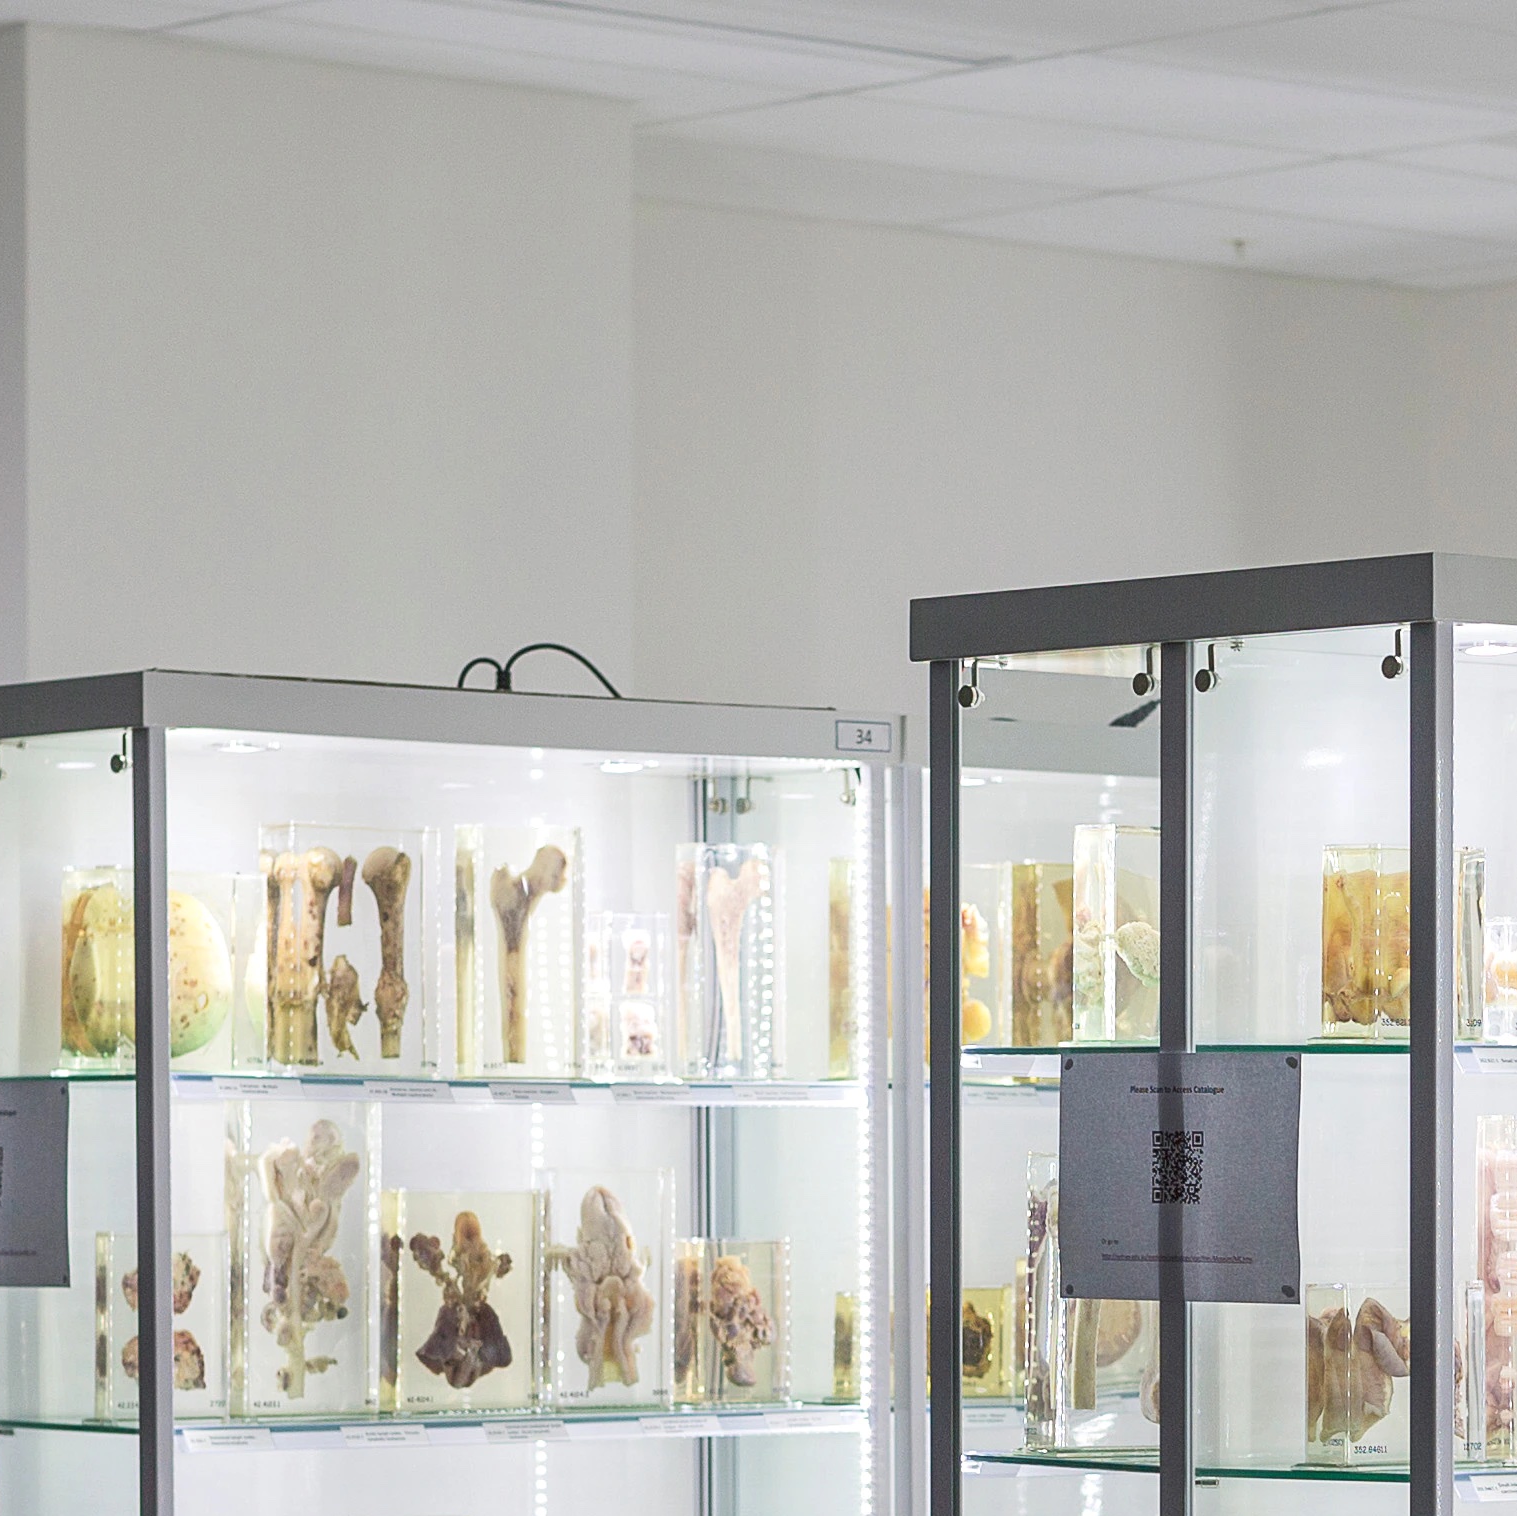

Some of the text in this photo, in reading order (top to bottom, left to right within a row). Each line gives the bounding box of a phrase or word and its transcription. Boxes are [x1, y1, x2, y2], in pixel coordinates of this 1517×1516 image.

[855, 729, 872, 745] 34
[1130, 1085, 1225, 1096] Please Scan to Access Catalogue
